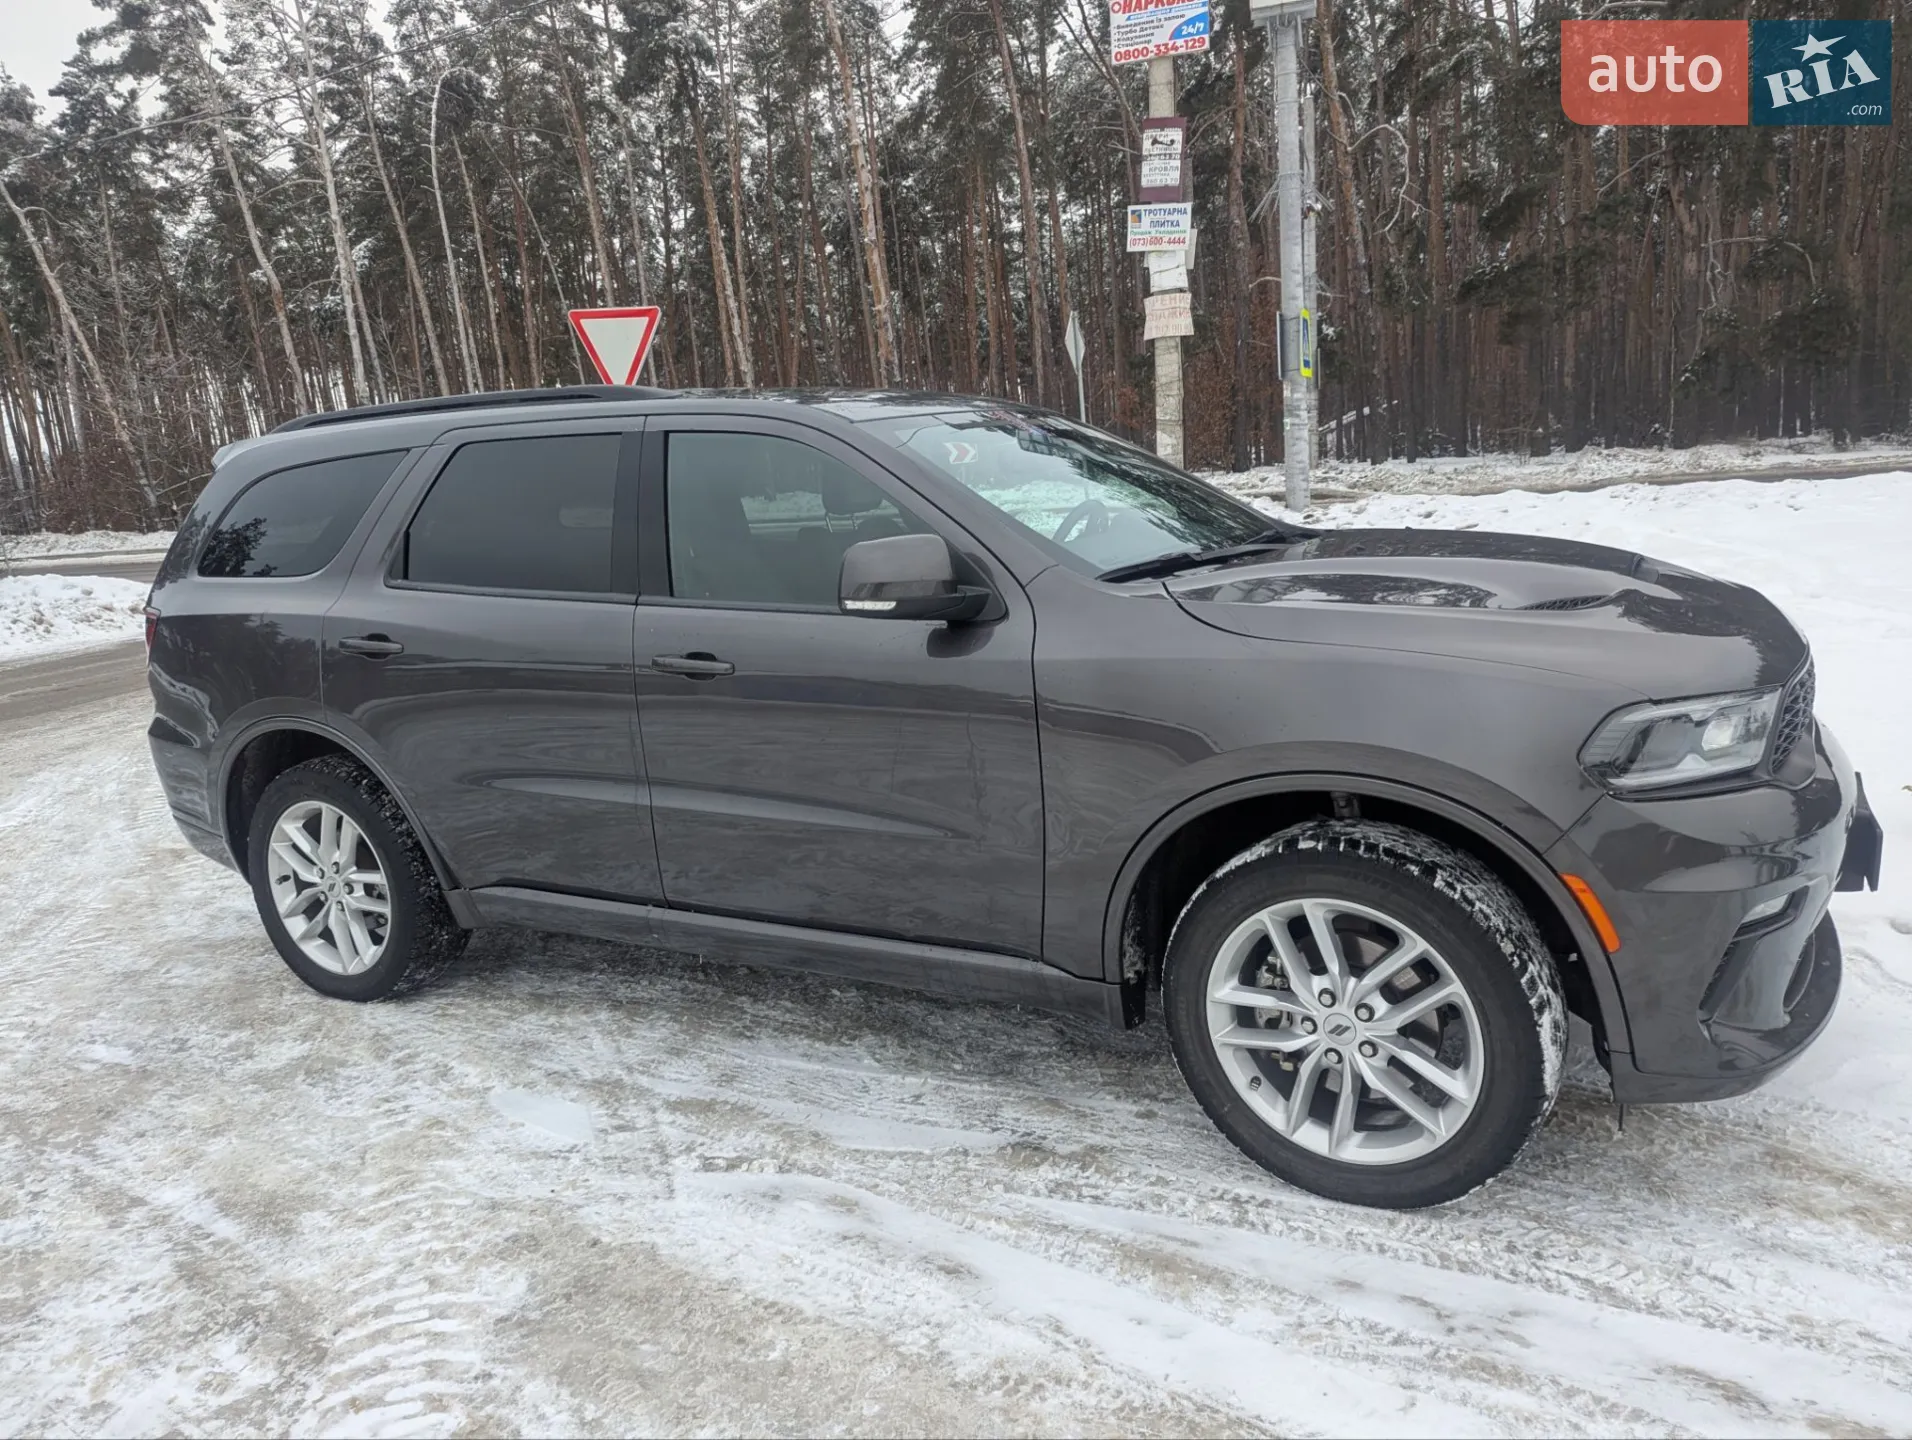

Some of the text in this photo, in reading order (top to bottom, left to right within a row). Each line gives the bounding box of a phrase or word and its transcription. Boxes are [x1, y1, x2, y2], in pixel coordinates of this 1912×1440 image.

[1122, 0, 1201, 14] НАРК
[1116, 28, 1138, 37] Турбо
[1181, 21, 1205, 35] 24/7
[1114, 36, 1206, 62] 0800-334-129
[1143, 207, 1188, 217] ТРОТУАРНА
[1150, 219, 1180, 228] ПЛИТКА
